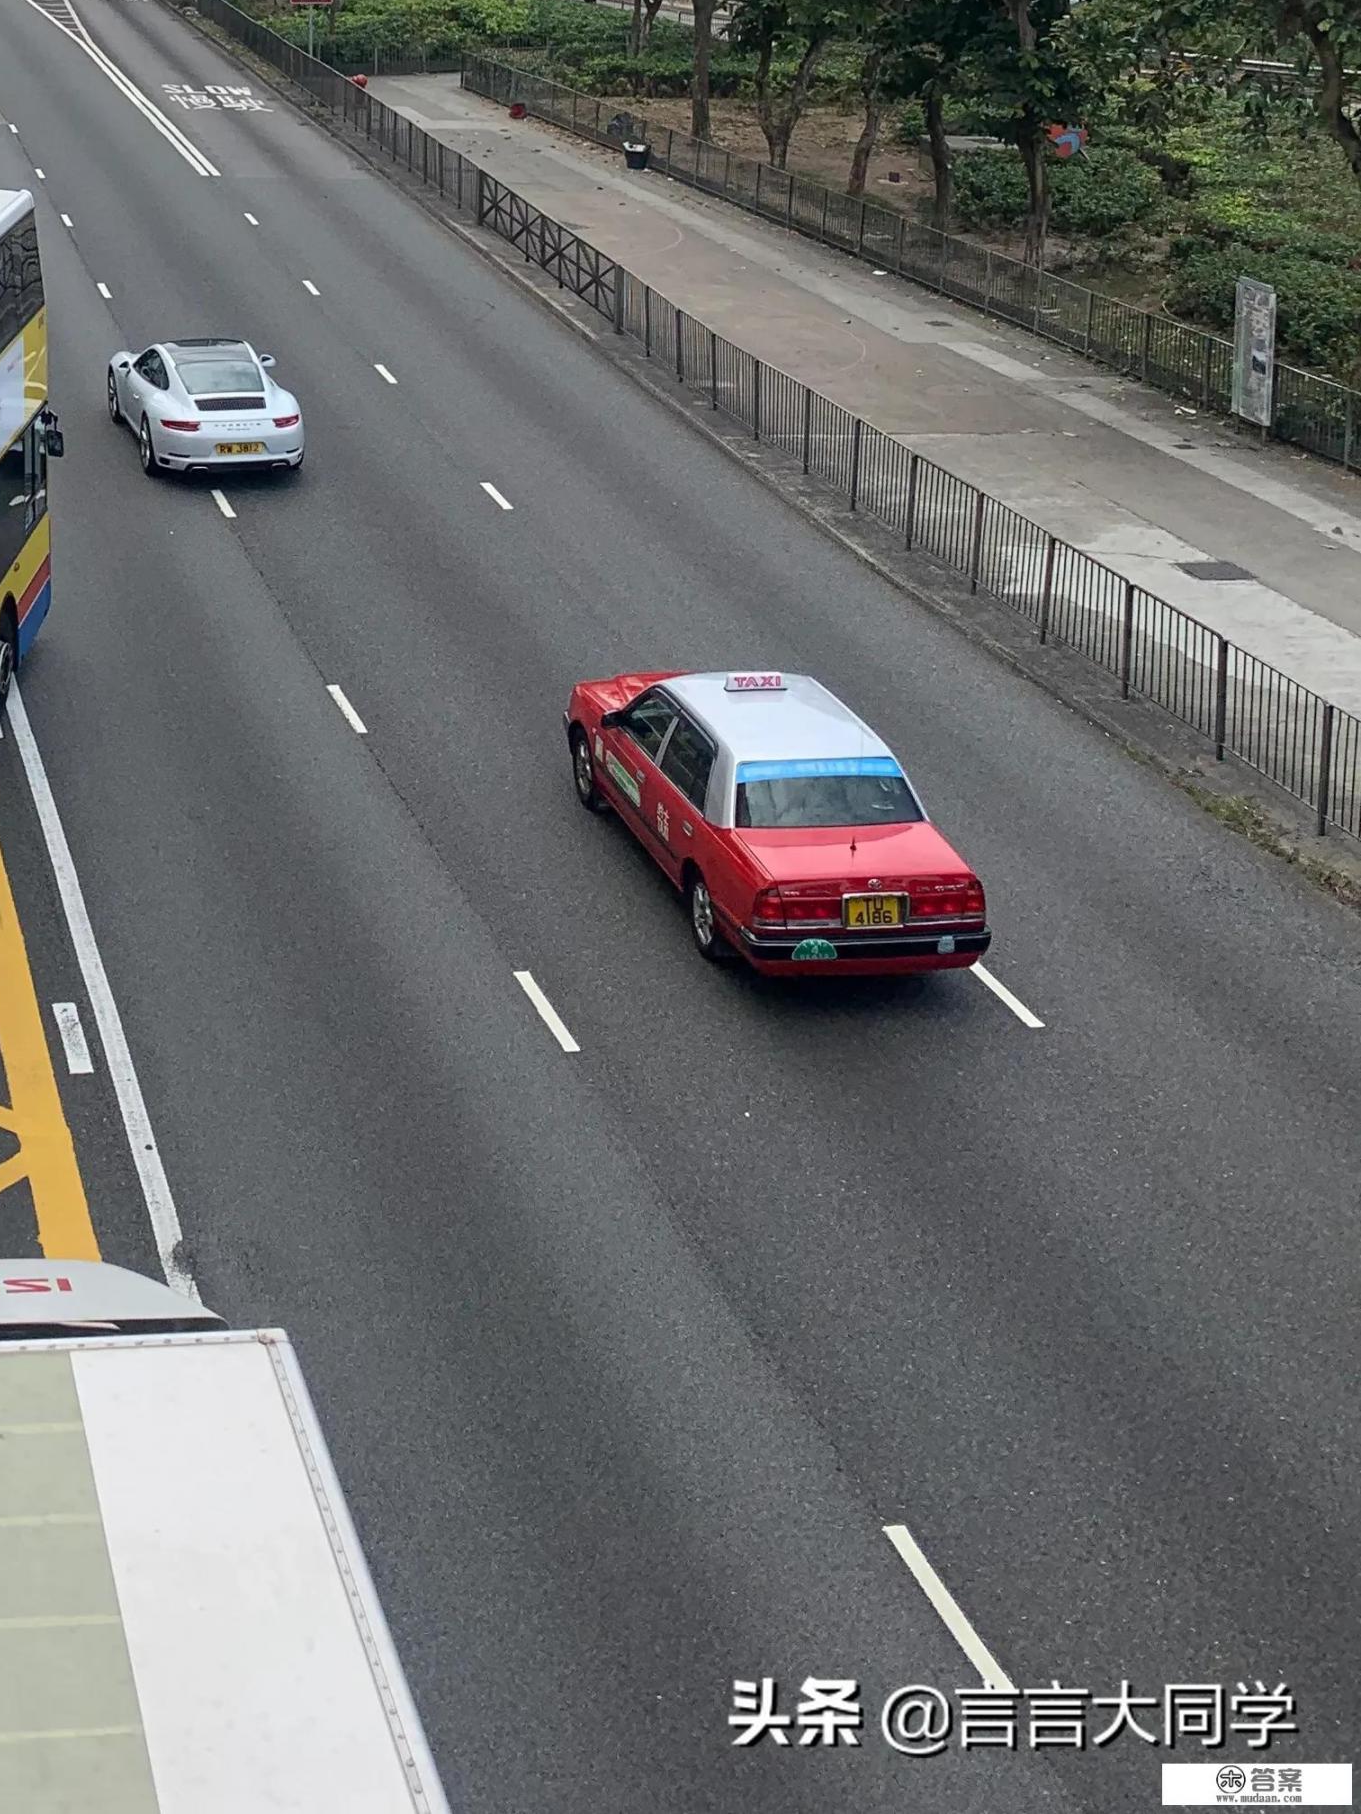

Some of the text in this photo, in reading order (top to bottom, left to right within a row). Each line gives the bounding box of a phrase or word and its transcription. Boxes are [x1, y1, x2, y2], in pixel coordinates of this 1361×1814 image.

[161, 84, 253, 96] SLOW
[169, 95, 275, 113] 慢駛
[734, 675, 781, 687] TAXI
[863, 896, 884, 911] TU
[854, 910, 893, 924] 4186
